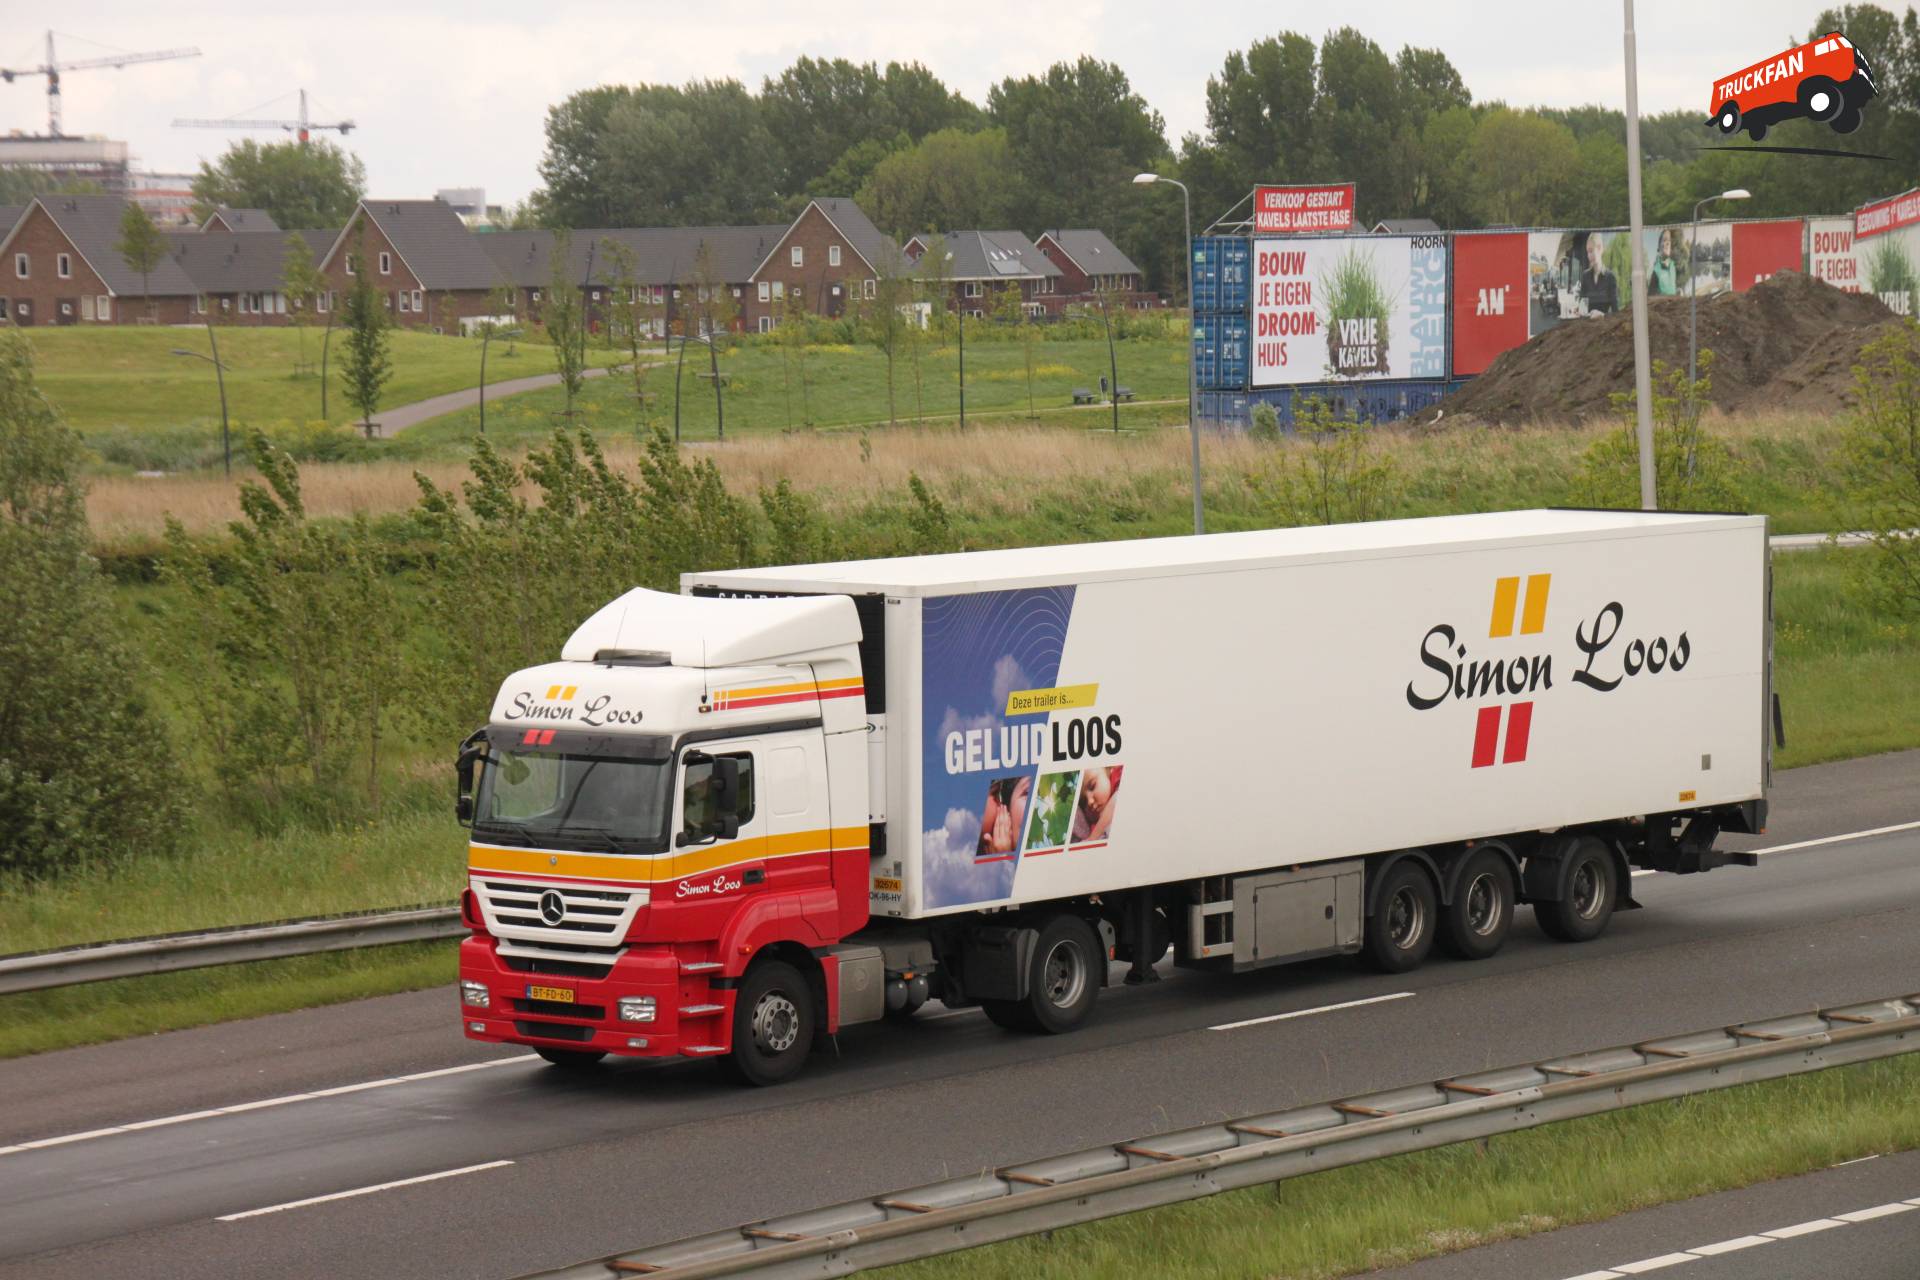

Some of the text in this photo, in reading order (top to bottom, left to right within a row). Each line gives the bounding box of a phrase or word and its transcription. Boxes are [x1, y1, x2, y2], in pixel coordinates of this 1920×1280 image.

[1264, 191, 1344, 208] VERKOOP GESTART
[1257, 209, 1350, 228] KAVELS LAATSTE FASE
[1411, 236, 1445, 249] HOORN
[1814, 231, 1852, 254] BOUW
[1259, 251, 1306, 276] BOUW
[1827, 258, 1856, 280] EIGEN
[1258, 282, 1311, 307] JE EIGEN
[1258, 311, 1320, 337] DROOM-
[1339, 318, 1377, 345] VRIJE
[1257, 342, 1287, 367] HUIS
[1339, 346, 1377, 368] KAVELS
[1406, 601, 1690, 711] Simon Loos
[504, 691, 643, 727] Simon Loos
[1012, 695, 1032, 709] Deze
[1034, 693, 1056, 708] trailer
[676, 875, 741, 898] Simon Loos
[533, 987, 571, 1001] BT-FD-60
